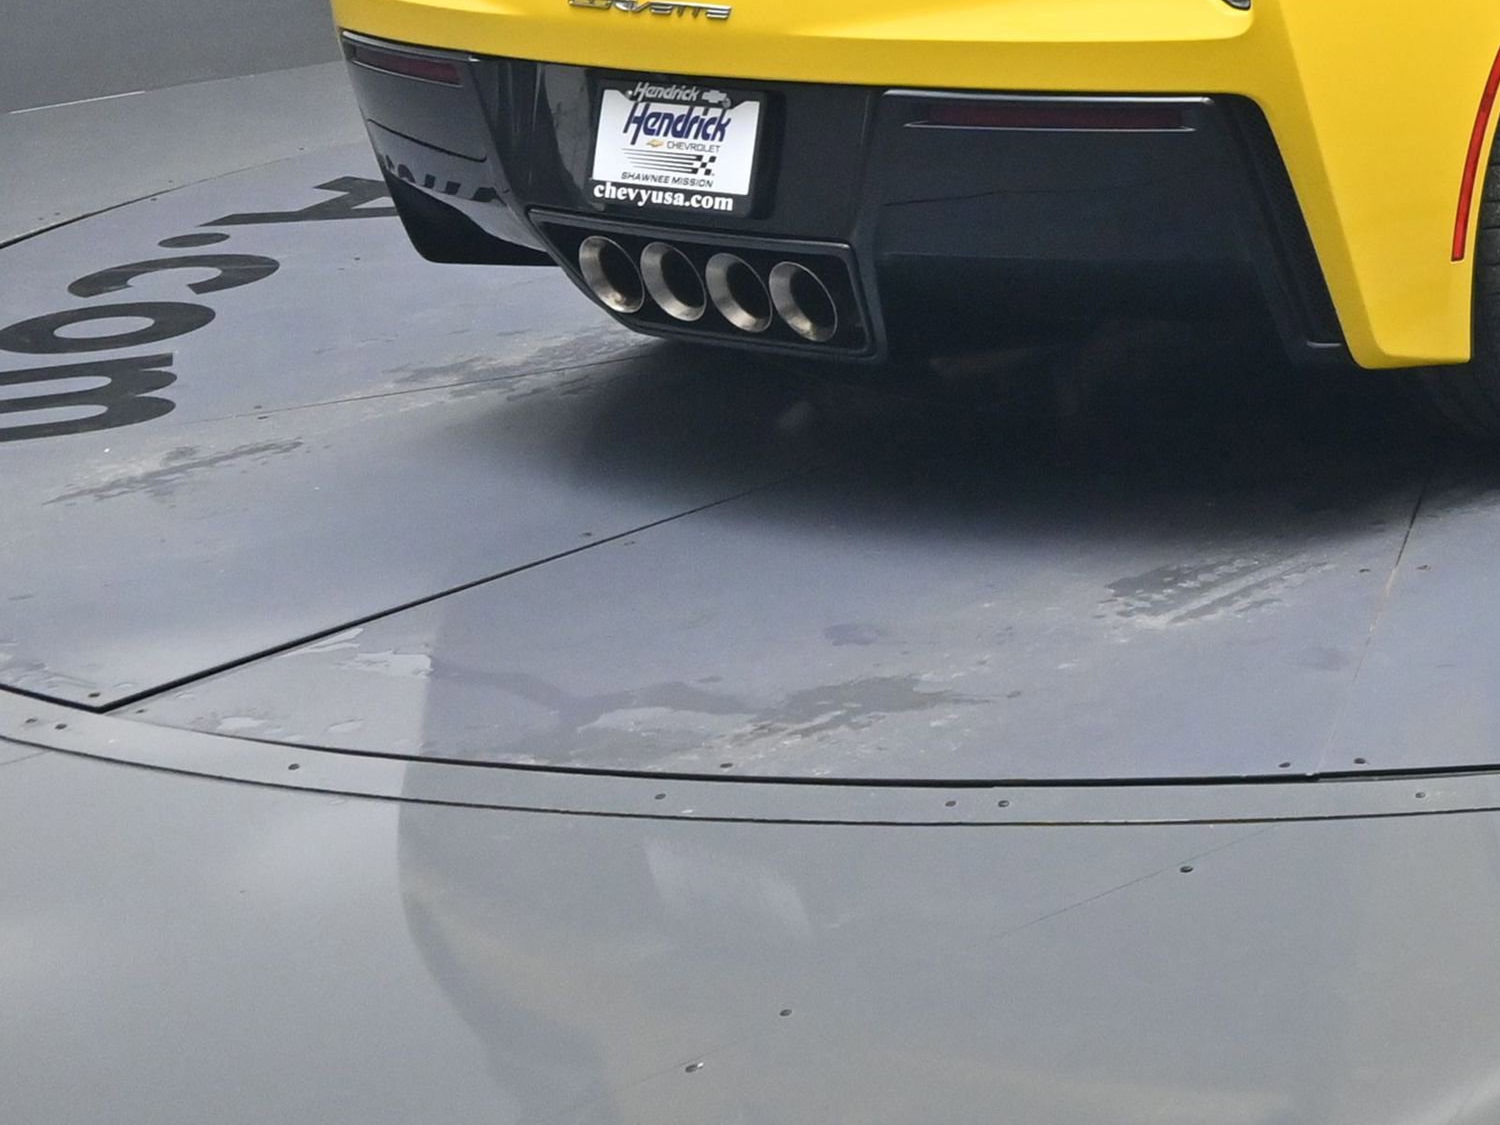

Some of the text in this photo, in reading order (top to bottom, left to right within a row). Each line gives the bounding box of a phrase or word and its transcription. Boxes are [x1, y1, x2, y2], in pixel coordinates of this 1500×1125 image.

[634, 82, 700, 103] Hendrick
[623, 102, 732, 146] Hendrick
[666, 140, 721, 154] CHEVROLET
[620, 171, 714, 188] SHAWNEE MISSION
[593, 182, 734, 211] chevyusa.com
